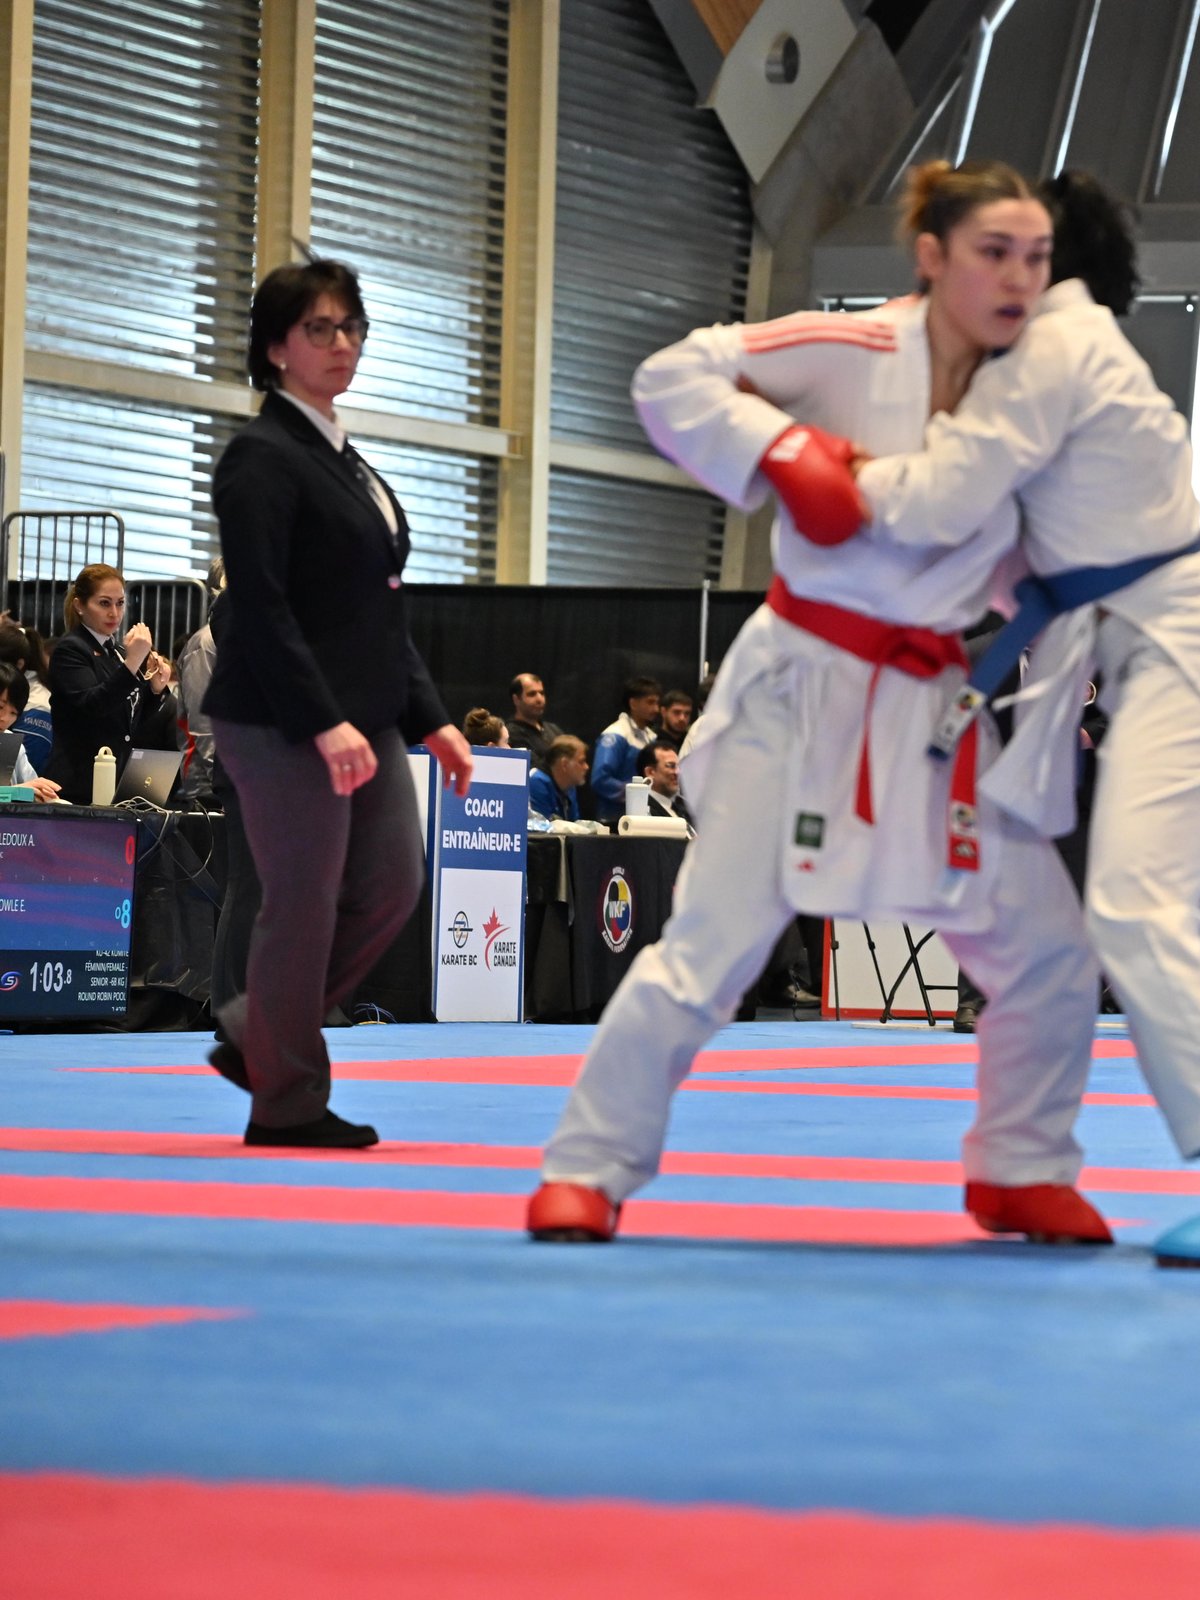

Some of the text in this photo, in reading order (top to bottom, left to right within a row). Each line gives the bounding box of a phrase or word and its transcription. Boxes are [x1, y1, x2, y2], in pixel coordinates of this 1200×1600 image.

[464, 797, 504, 818] COACH
[493, 941, 517, 954] KARATE
[441, 953, 478, 966] KARATE BC
[493, 955, 517, 967] CANADA
[78, 991, 97, 1001] ROUND
[97, 991, 112, 1001] ROBIN
